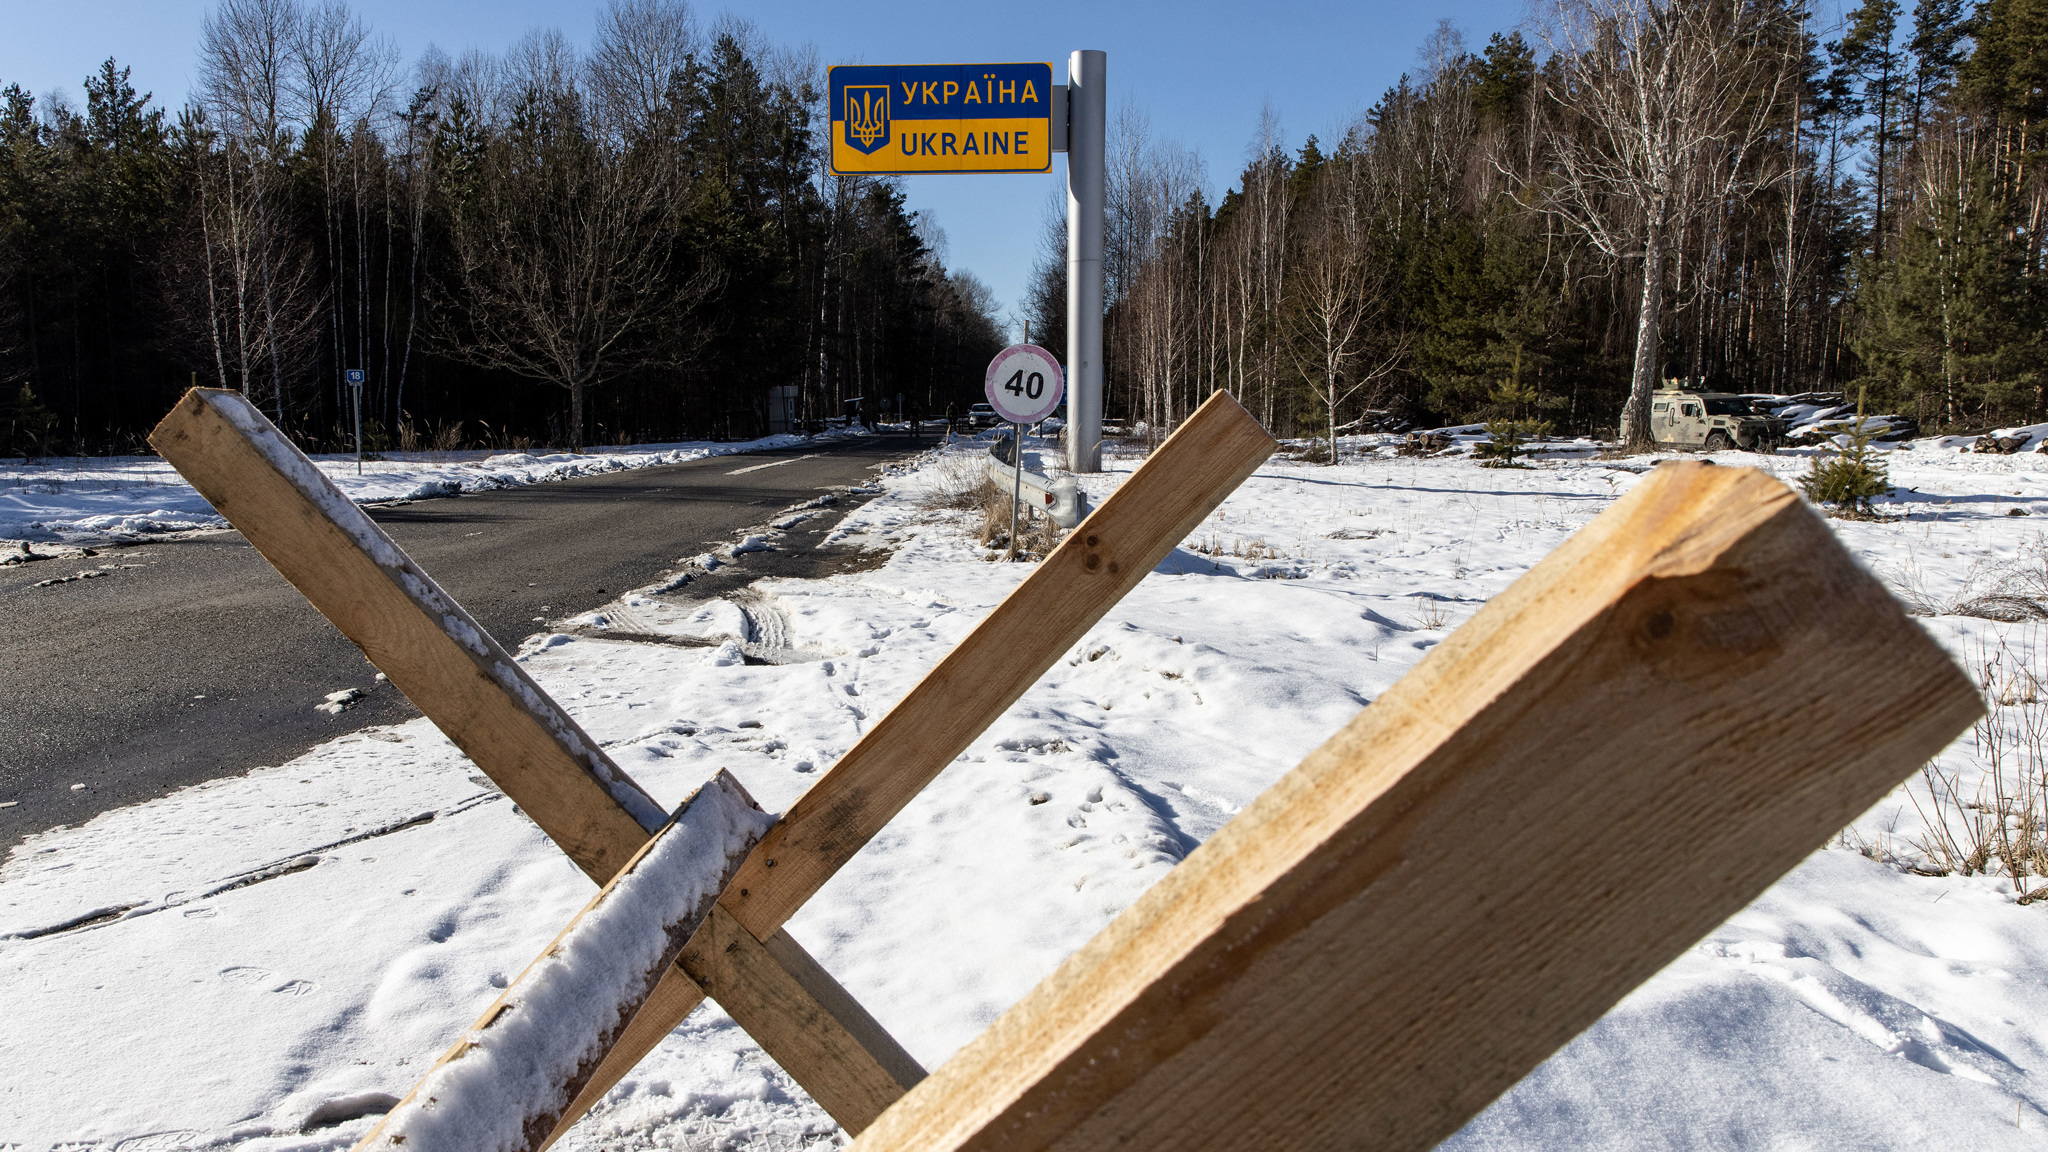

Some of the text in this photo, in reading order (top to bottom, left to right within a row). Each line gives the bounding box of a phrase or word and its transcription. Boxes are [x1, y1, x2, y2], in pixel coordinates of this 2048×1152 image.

[901, 73, 1039, 105] УКРАЇНА
[901, 131, 1029, 156] UKRAINE
[350, 371, 361, 380] 18
[1004, 369, 1044, 400] 40
